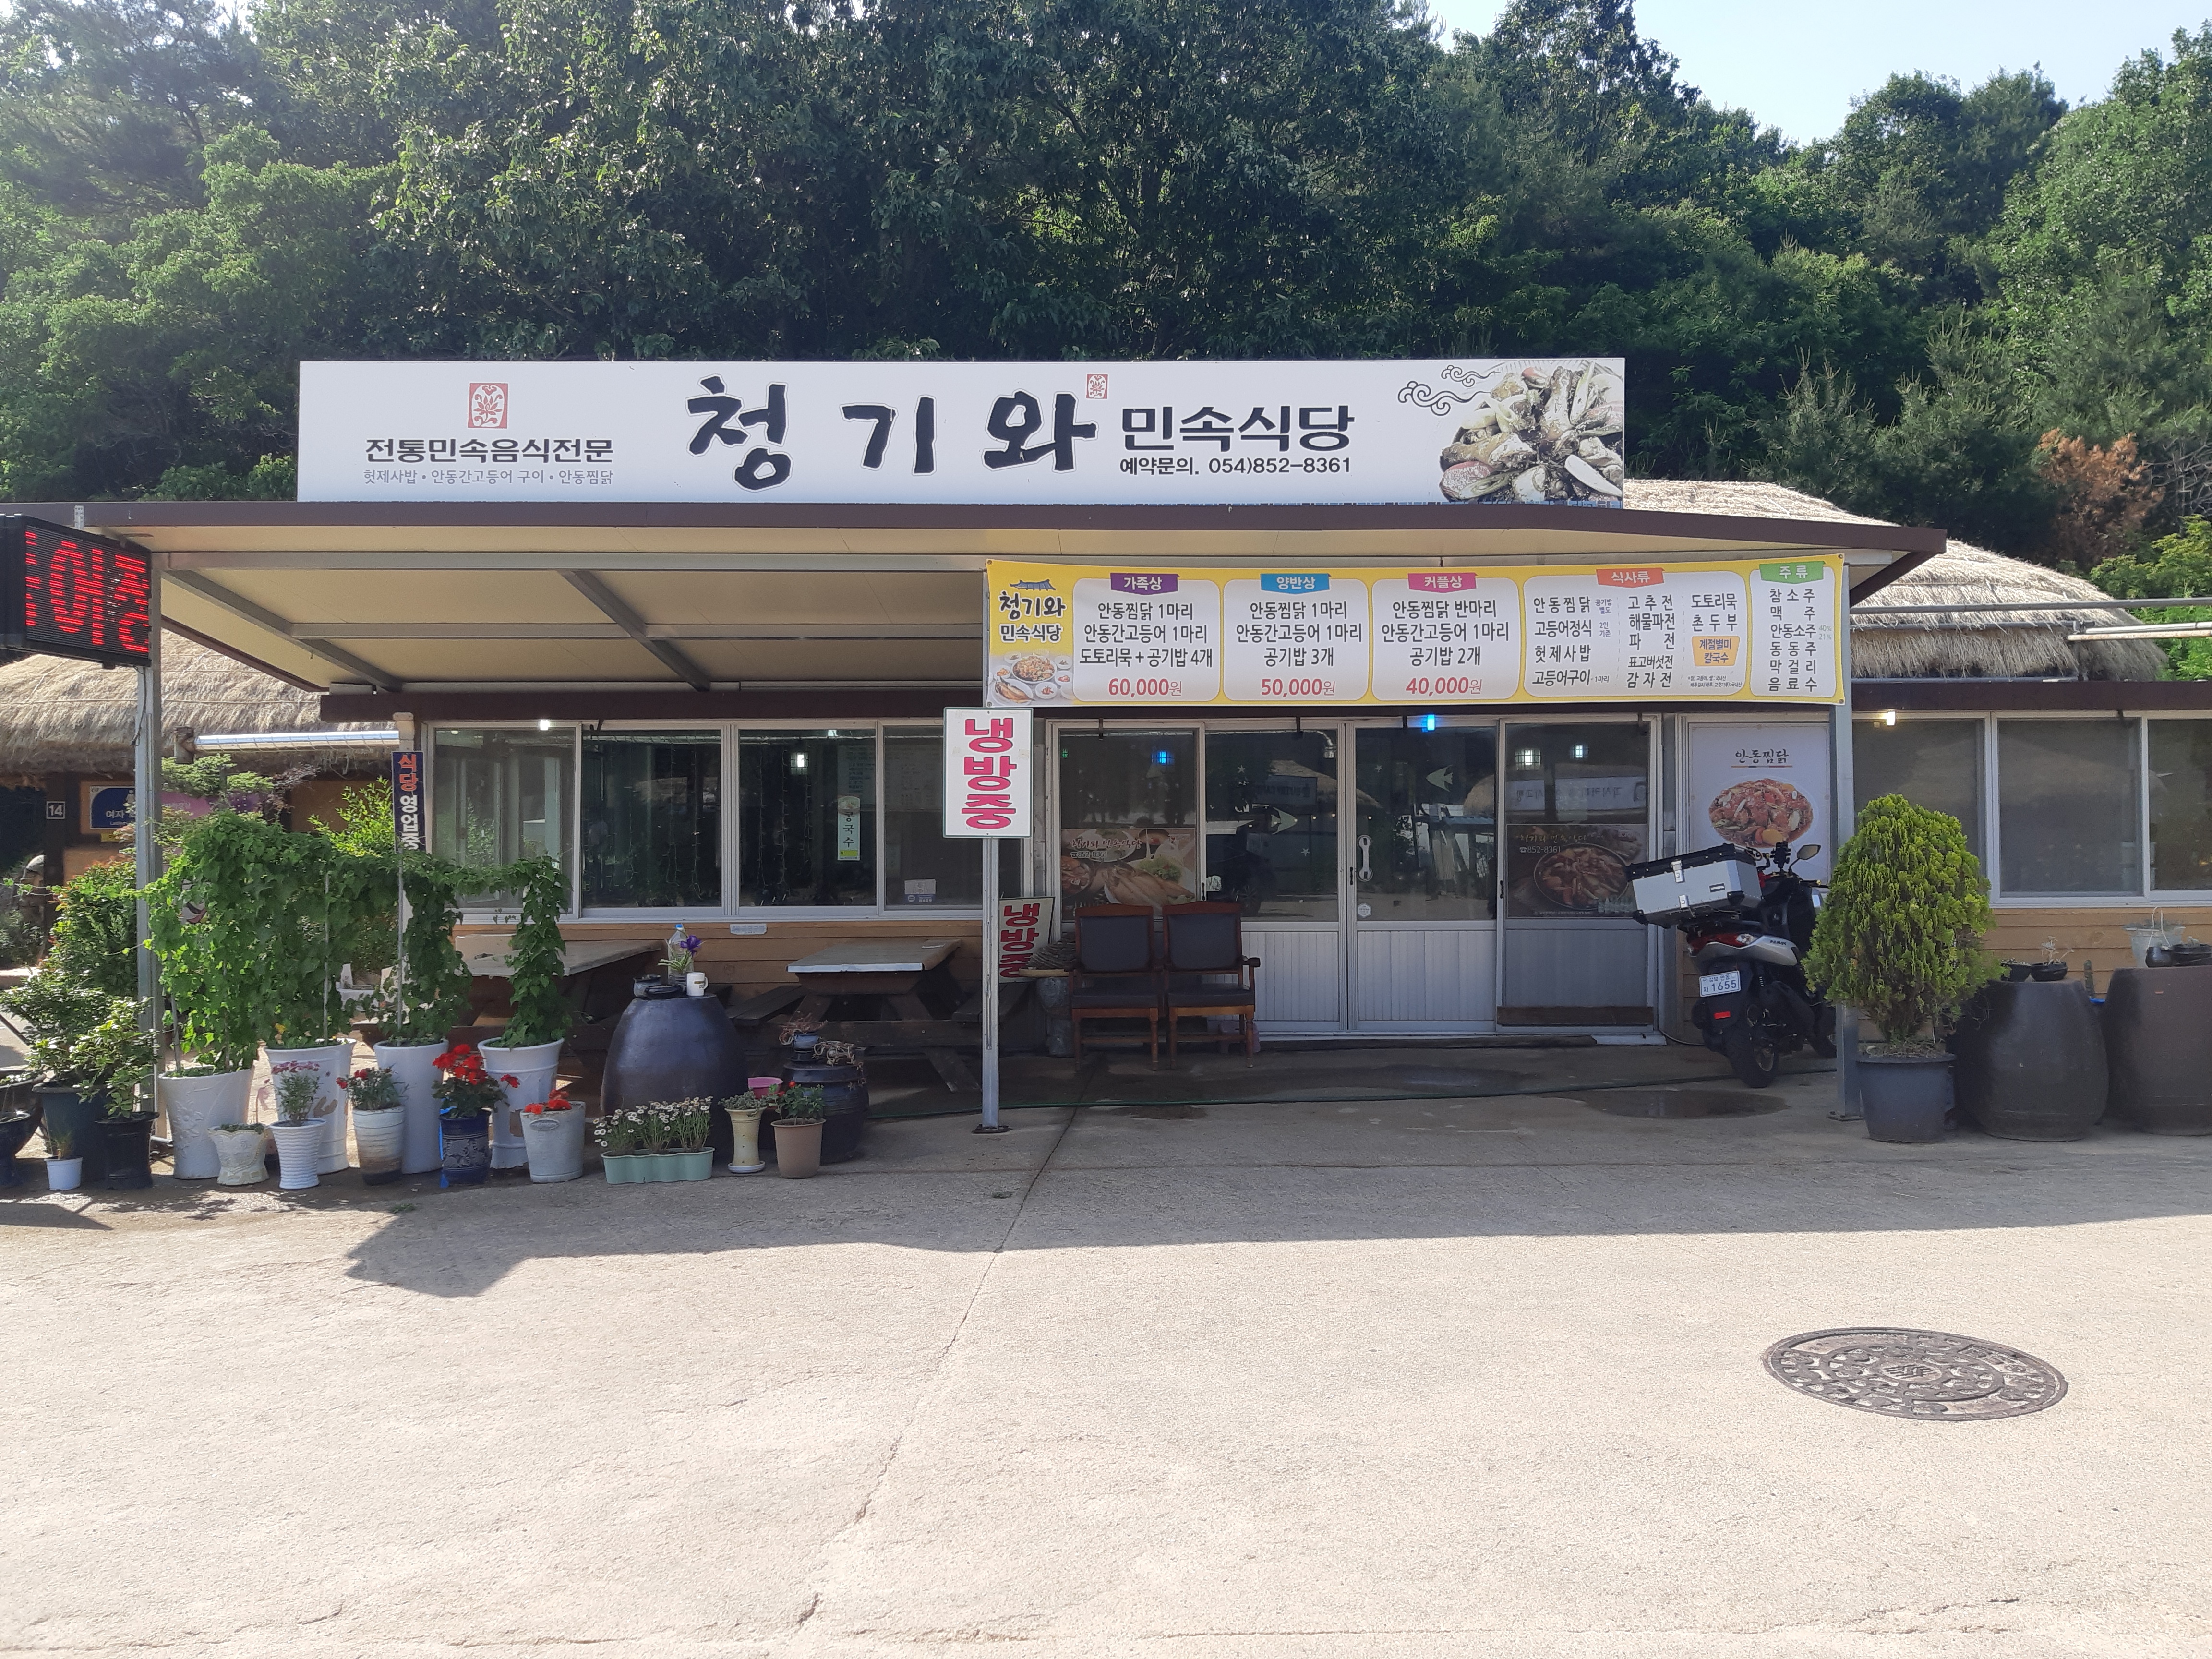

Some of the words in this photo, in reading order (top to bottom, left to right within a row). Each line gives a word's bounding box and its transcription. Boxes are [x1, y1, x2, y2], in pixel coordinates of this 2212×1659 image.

[1122, 406, 1355, 451] 민속식당
[365, 438, 614, 463] 전통민속음식전문
[1120, 457, 1199, 475] 예약문의.
[1209, 457, 1350, 474] 054)852-8361
[363, 469, 418, 485] 헛제사밥
[431, 469, 512, 485] 안동간고등어
[517, 470, 544, 485] 구이
[559, 469, 613, 485] 안동찜닭
[1611, 571, 1650, 584] 식사류
[1779, 565, 1808, 579] 주류
[1124, 577, 1162, 590] 가족상
[1276, 577, 1315, 590] 양반상
[1424, 576, 1462, 589] 커플상
[1533, 596, 1591, 613] 안동찜닭
[1628, 595, 1673, 611] 고추전
[1691, 593, 1737, 610] 도토리묵
[1770, 589, 1815, 603] 참소주
[999, 591, 1065, 620] 청기와
[1098, 603, 1152, 621] 안동찜닭
[1158, 603, 1193, 620] 1마리
[1250, 601, 1306, 620] 안동찜닭
[1311, 601, 1347, 619] 1마리
[1393, 601, 1449, 619] 안동찜닭
[1455, 600, 1497, 618] 반마리
[1534, 619, 1592, 637] 고등어정식
[1629, 613, 1675, 631] 해물파전
[1692, 614, 1738, 631] 촌두부
[1000, 625, 1062, 642] 민속식당
[1084, 625, 1166, 643] 안동간고등어
[1173, 625, 1207, 643] 1마리
[1236, 624, 1320, 643] 안동간고등어
[1327, 624, 1362, 643] 1마리
[1382, 623, 1467, 643] 안동간고등어
[1473, 622, 1509, 641] 1마리
[1771, 624, 1816, 639] 안동소주
[1699, 639, 1731, 650] 계절별미
[1770, 641, 1816, 657] 동동주
[1079, 648, 1132, 667] 도토리묵
[1147, 648, 1188, 667] 공기밥
[1191, 648, 1212, 667] 4개
[1264, 647, 1306, 667] 공기밥
[1311, 648, 1334, 667] 3개
[1409, 647, 1453, 666] 공기밥
[1457, 646, 1480, 666] 2개
[1628, 655, 1673, 669] 표고버섯전
[1704, 653, 1729, 664] 칼국수
[1770, 659, 1816, 674] 막걸리
[1532, 669, 1590, 686] 고등어구이
[1627, 672, 1671, 688] 감자전
[1767, 677, 1817, 692] 음료수
[1108, 678, 1182, 698] 60,000원
[1261, 678, 1335, 698] 50,000원
[1406, 677, 1481, 697] 40,000원
[1735, 749, 1789, 764] 안동찜닭
[398, 754, 418, 792] 식당
[962, 718, 1017, 829] 냉방중
[49, 805, 63, 816] 14
[106, 809, 125, 819] 여자
[843, 812, 854, 848] 콩국수
[1711, 979, 1737, 992] 1655
